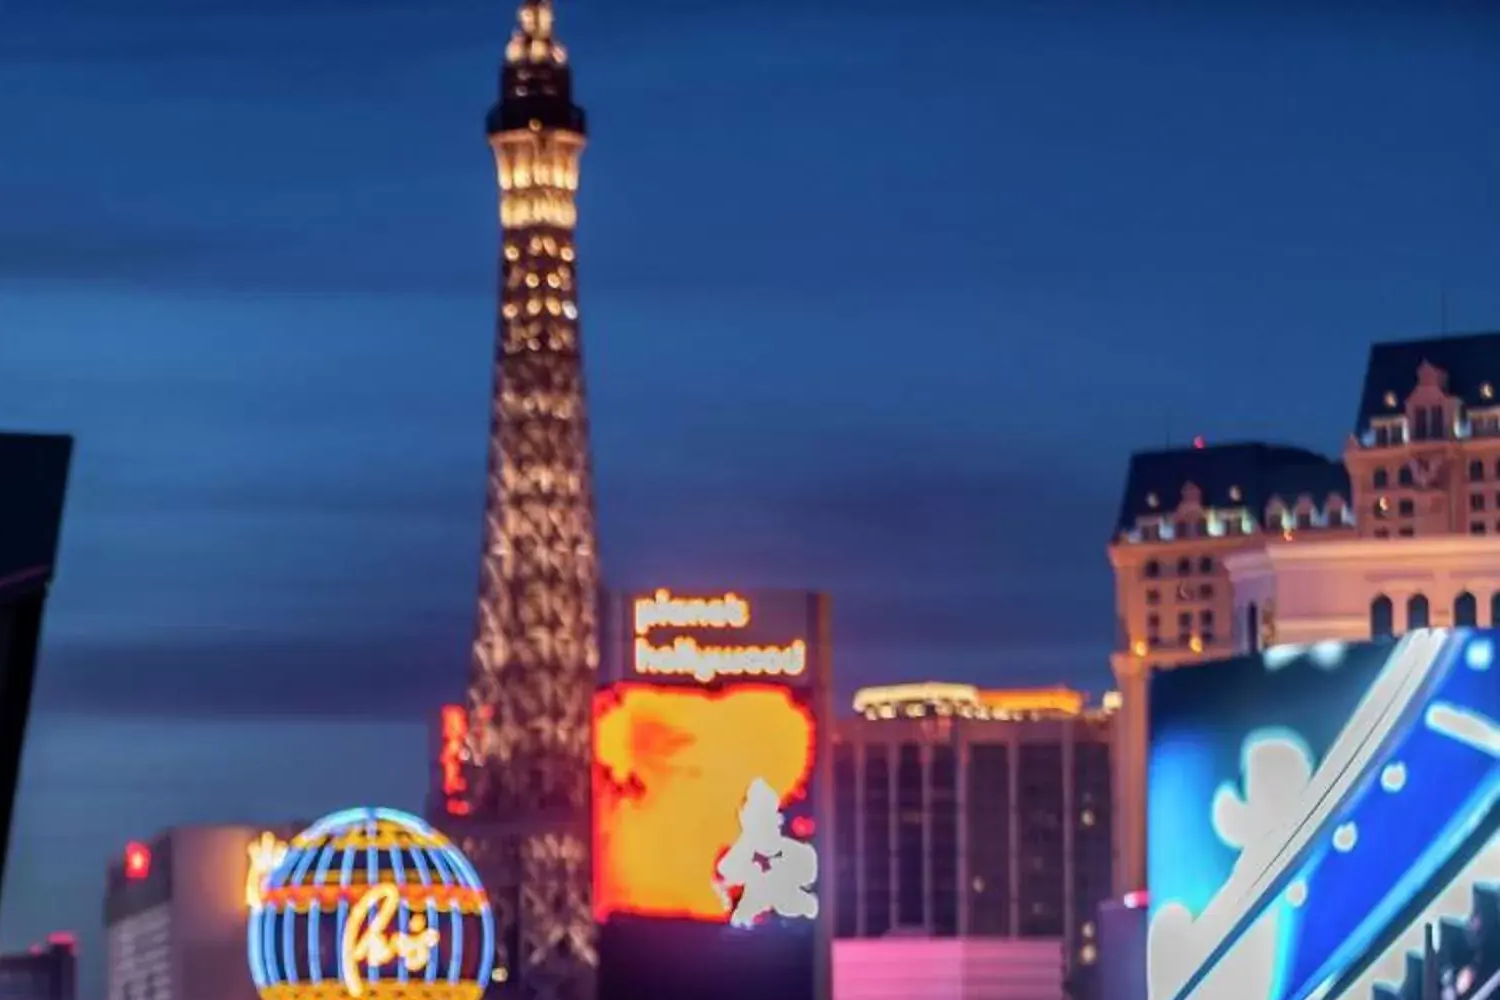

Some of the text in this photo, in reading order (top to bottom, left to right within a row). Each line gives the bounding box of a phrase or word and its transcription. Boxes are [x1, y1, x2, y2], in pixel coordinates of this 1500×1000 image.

[635, 588, 750, 635] planet
[635, 636, 805, 682] hollywood
[342, 882, 440, 998] Paris
